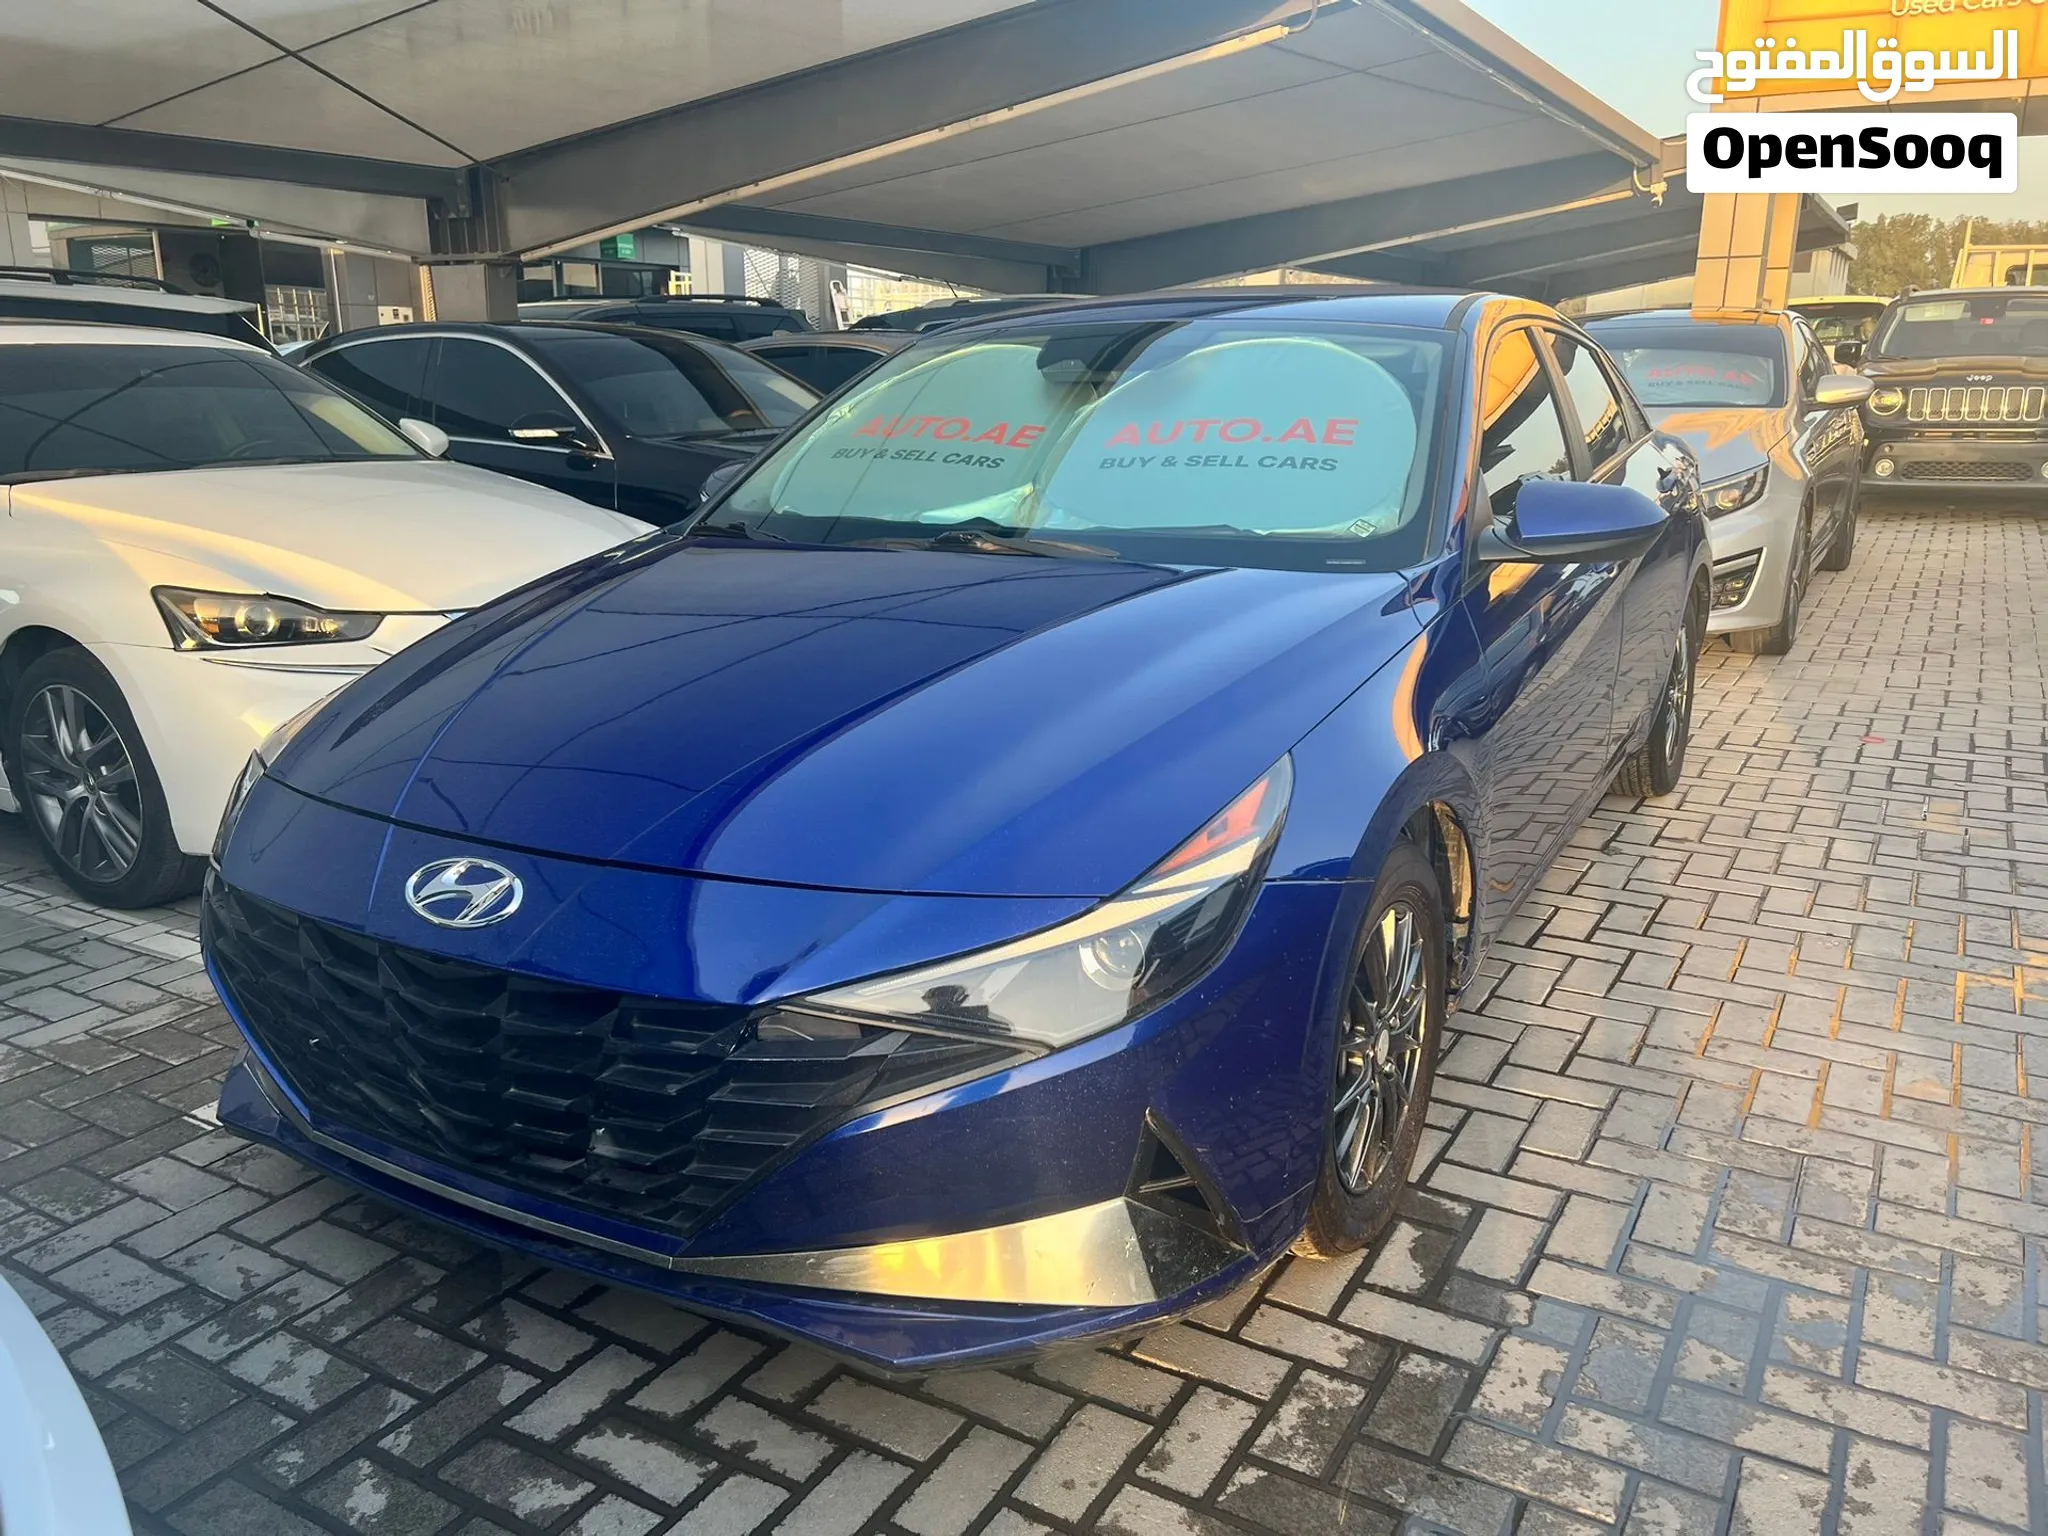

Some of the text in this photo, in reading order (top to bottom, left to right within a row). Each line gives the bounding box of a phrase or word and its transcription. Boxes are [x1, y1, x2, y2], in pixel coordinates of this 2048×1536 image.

[1965, 374, 1993, 382] Jeep
[851, 414, 1047, 449] AUTO.AE
[1104, 416, 1359, 447] AUTO.AE
[831, 447, 1006, 469] BUY & SELL CARS
[1099, 454, 1339, 472] BUY & SELL CARS
